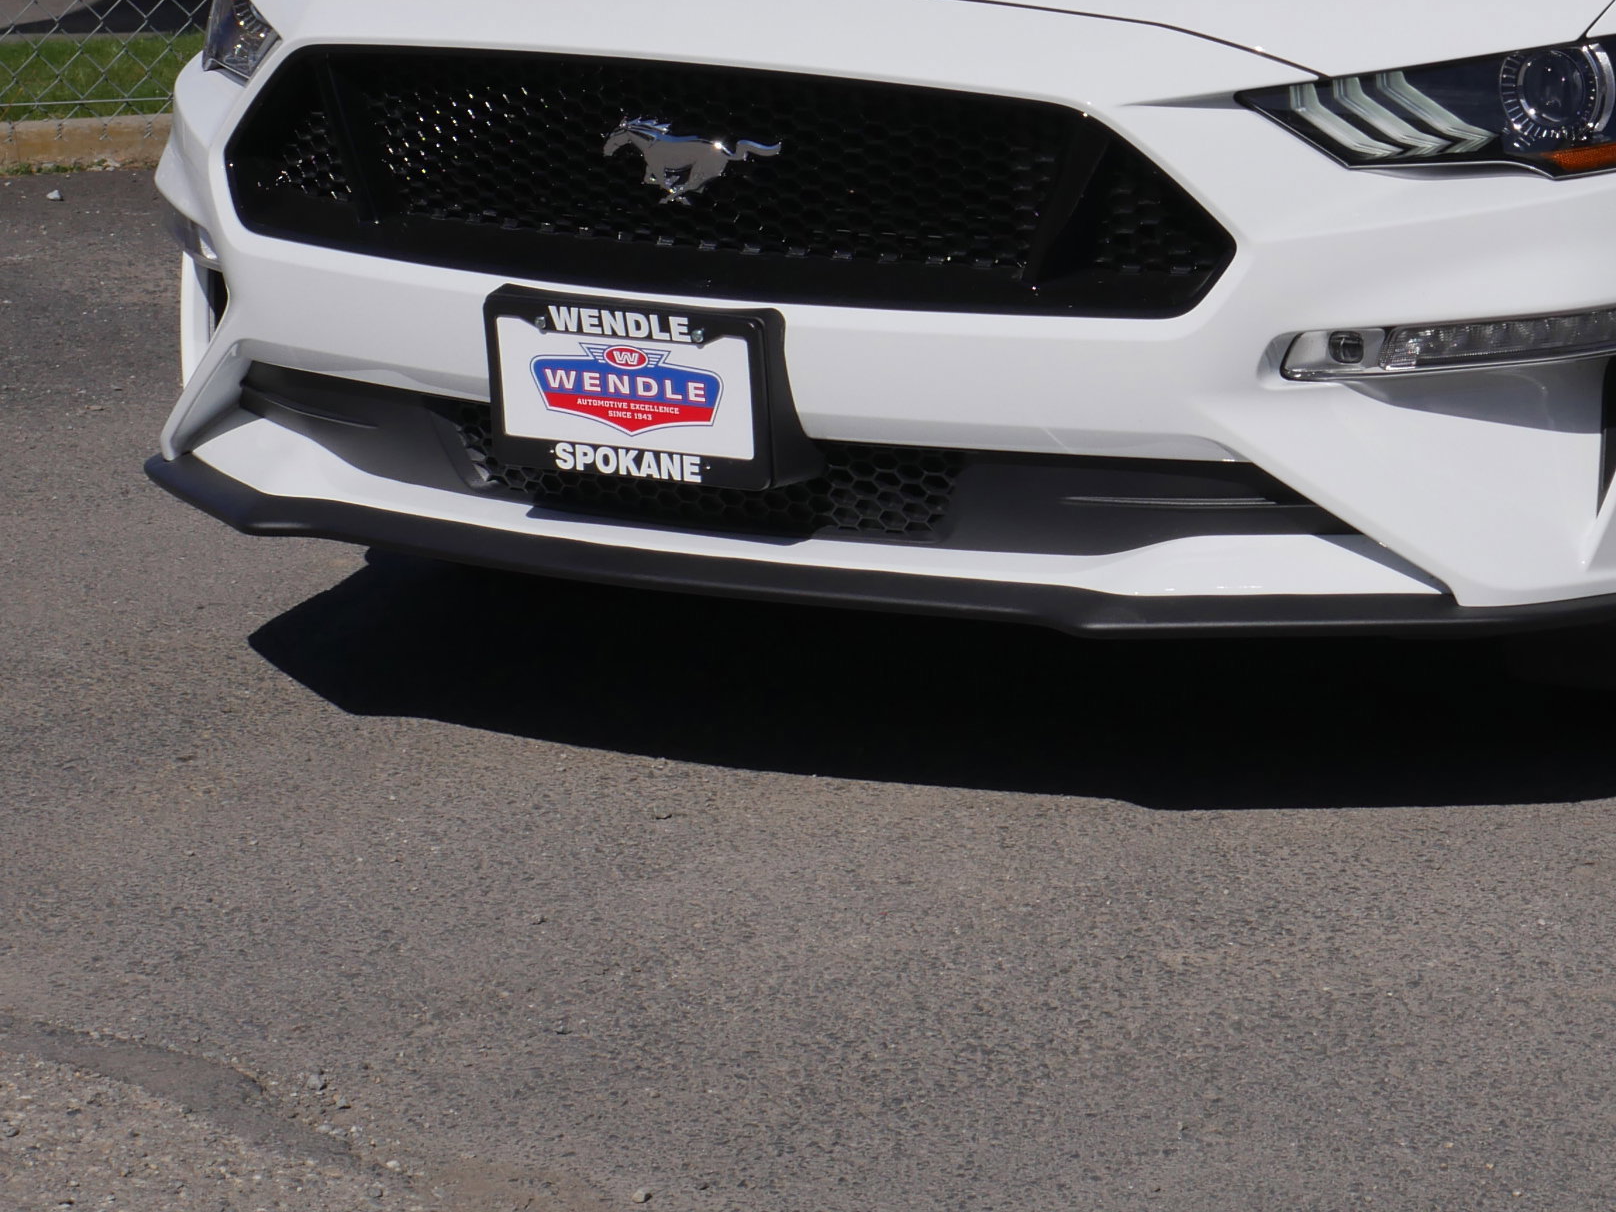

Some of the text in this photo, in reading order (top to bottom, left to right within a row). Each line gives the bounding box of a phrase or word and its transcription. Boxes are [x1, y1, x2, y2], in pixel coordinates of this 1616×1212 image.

[548, 305, 692, 342] WENDLE
[545, 368, 706, 402] WENDLE
[576, 398, 680, 415] AUTOMOTIVE EXCELLENCE
[608, 410, 653, 421] SINCE 1943
[554, 441, 702, 483] SPOKANE
